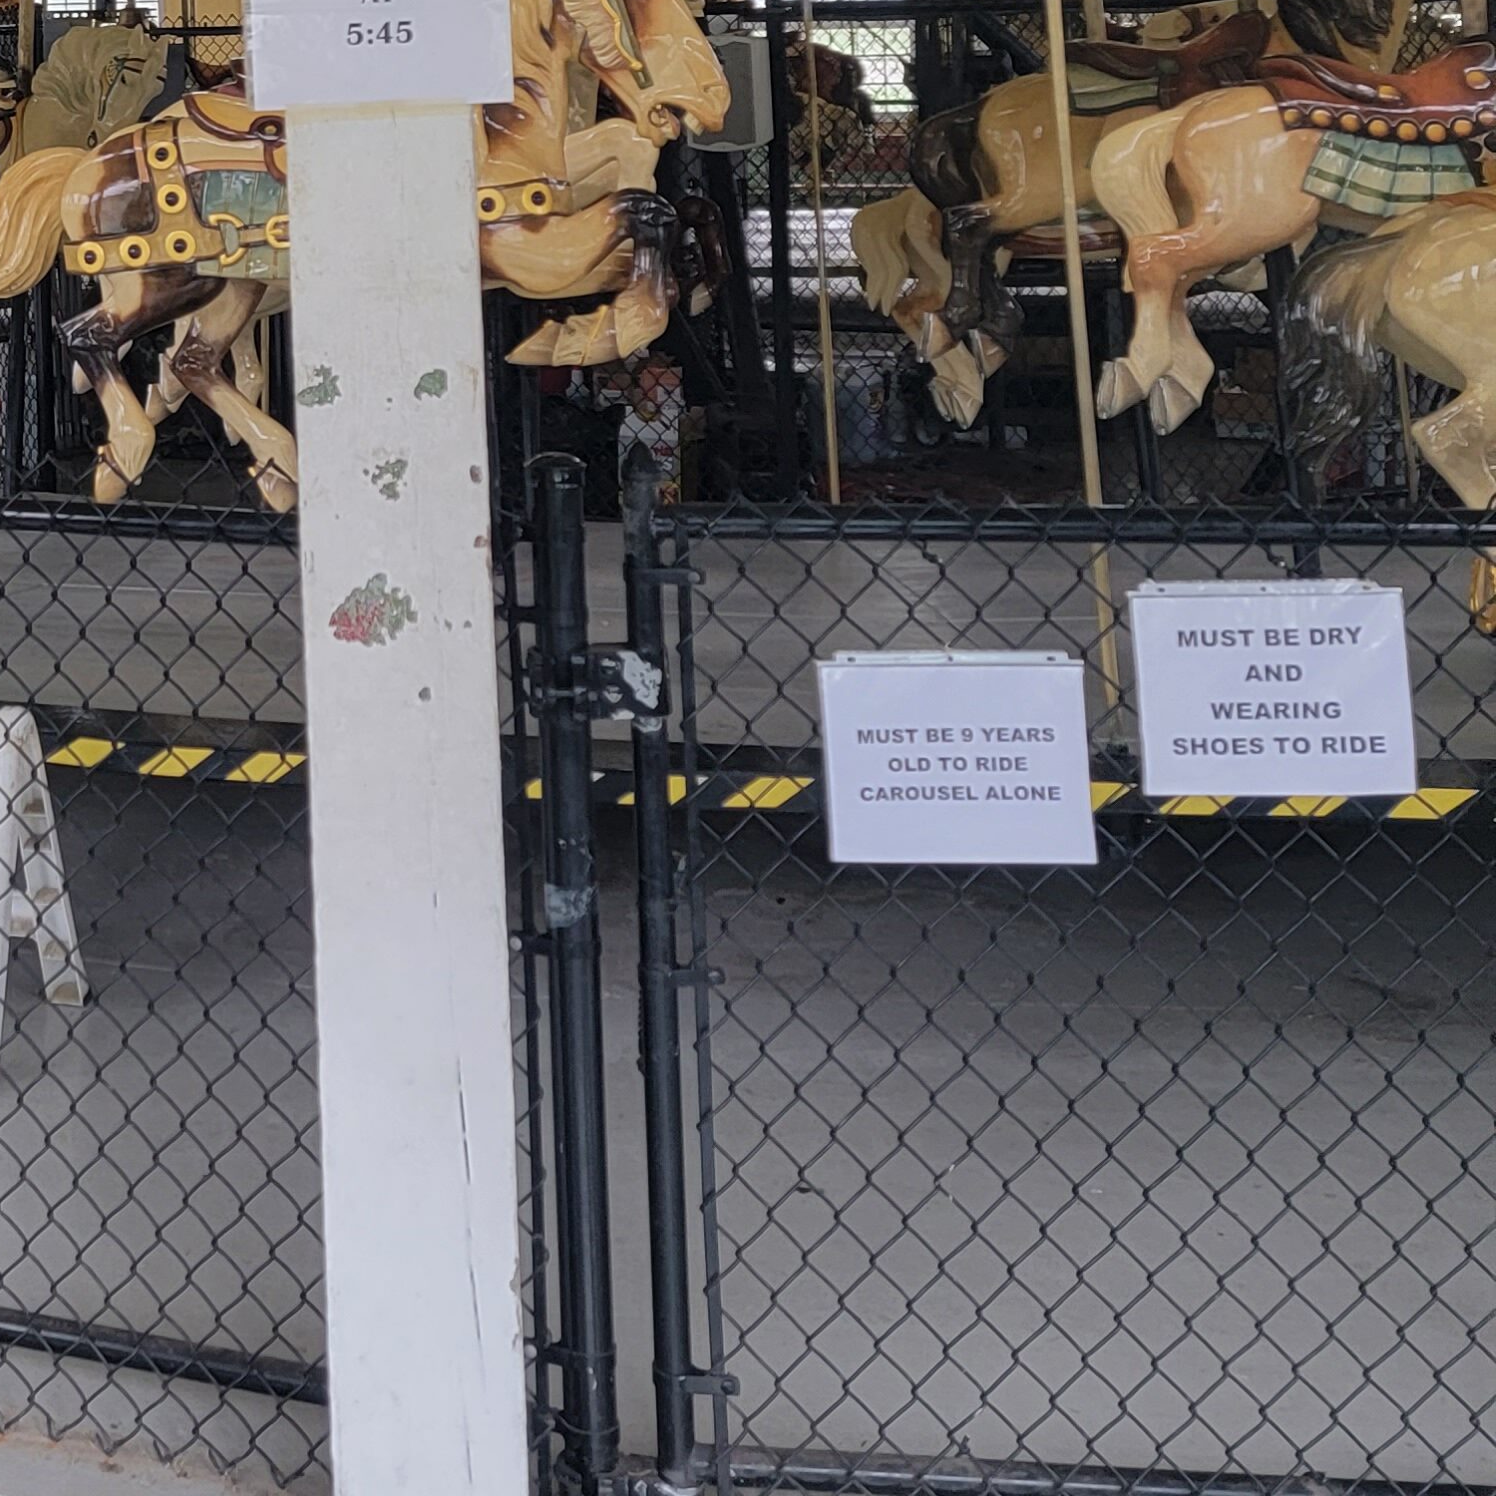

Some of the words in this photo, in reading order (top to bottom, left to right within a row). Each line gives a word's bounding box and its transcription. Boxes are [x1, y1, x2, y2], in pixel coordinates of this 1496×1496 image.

[346, 20, 414, 46] 5:45
[1177, 628, 1254, 648] MUST
[1264, 628, 1301, 647] BE
[1309, 626, 1363, 646] DRY
[1244, 664, 1304, 682] AND
[1210, 701, 1342, 720] WEARING
[857, 728, 919, 745] MUST
[925, 727, 955, 744] BE
[960, 727, 974, 743] 9
[980, 727, 1056, 743] YEARS
[1172, 737, 1265, 756] SHOES
[1273, 736, 1311, 754] TO
[1321, 735, 1387, 754] RIDE
[887, 756, 932, 773] OLD
[937, 756, 968, 772] TO
[975, 756, 1028, 772] RIDE
[859, 785, 979, 802] CAROUSEL
[985, 785, 1062, 801] ALONE
